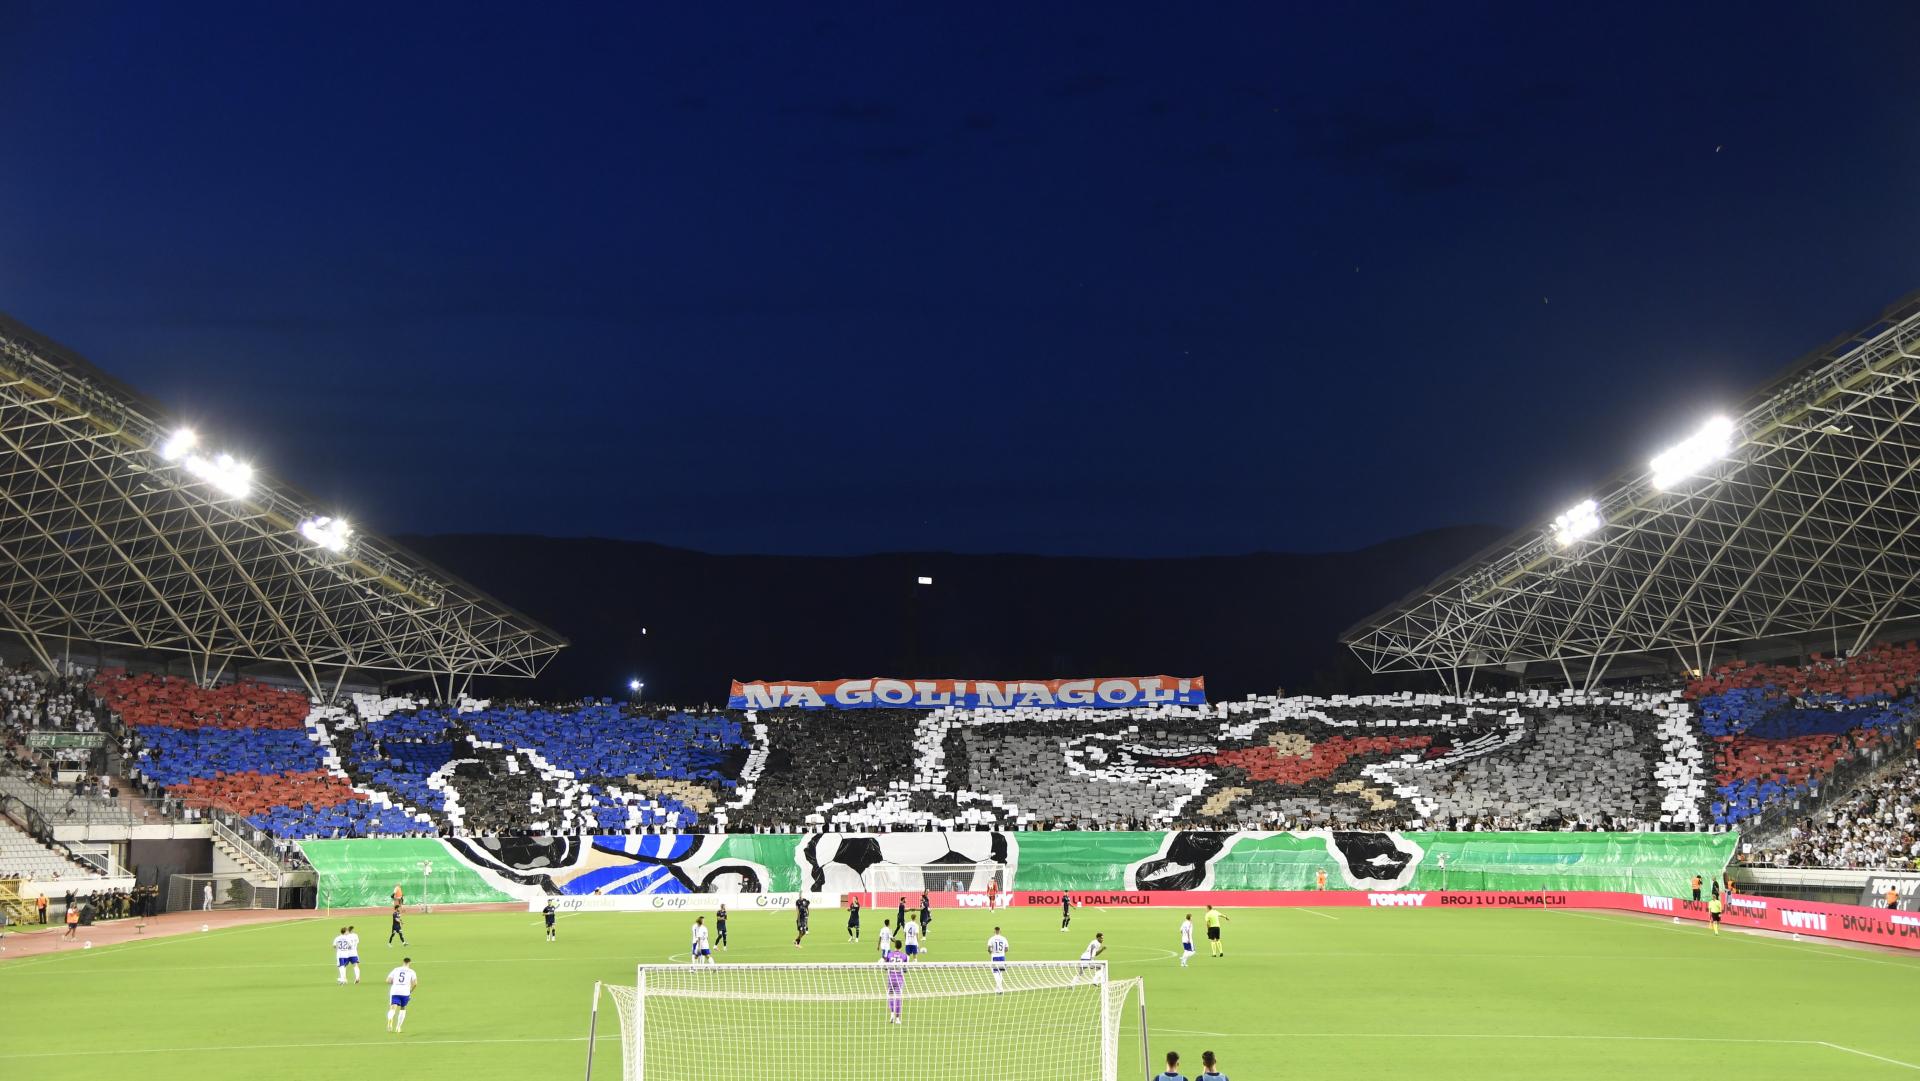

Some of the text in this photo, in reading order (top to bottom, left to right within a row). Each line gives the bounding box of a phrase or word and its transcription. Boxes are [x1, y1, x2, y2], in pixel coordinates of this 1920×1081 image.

[743, 685, 826, 708] NA
[835, 679, 966, 706] GOL!
[1028, 895, 1060, 905] BROJ
[1085, 895, 1150, 905] DALMACIJI
[1367, 893, 1566, 907] TOMMY BROJ 1 U DALMACIJI
